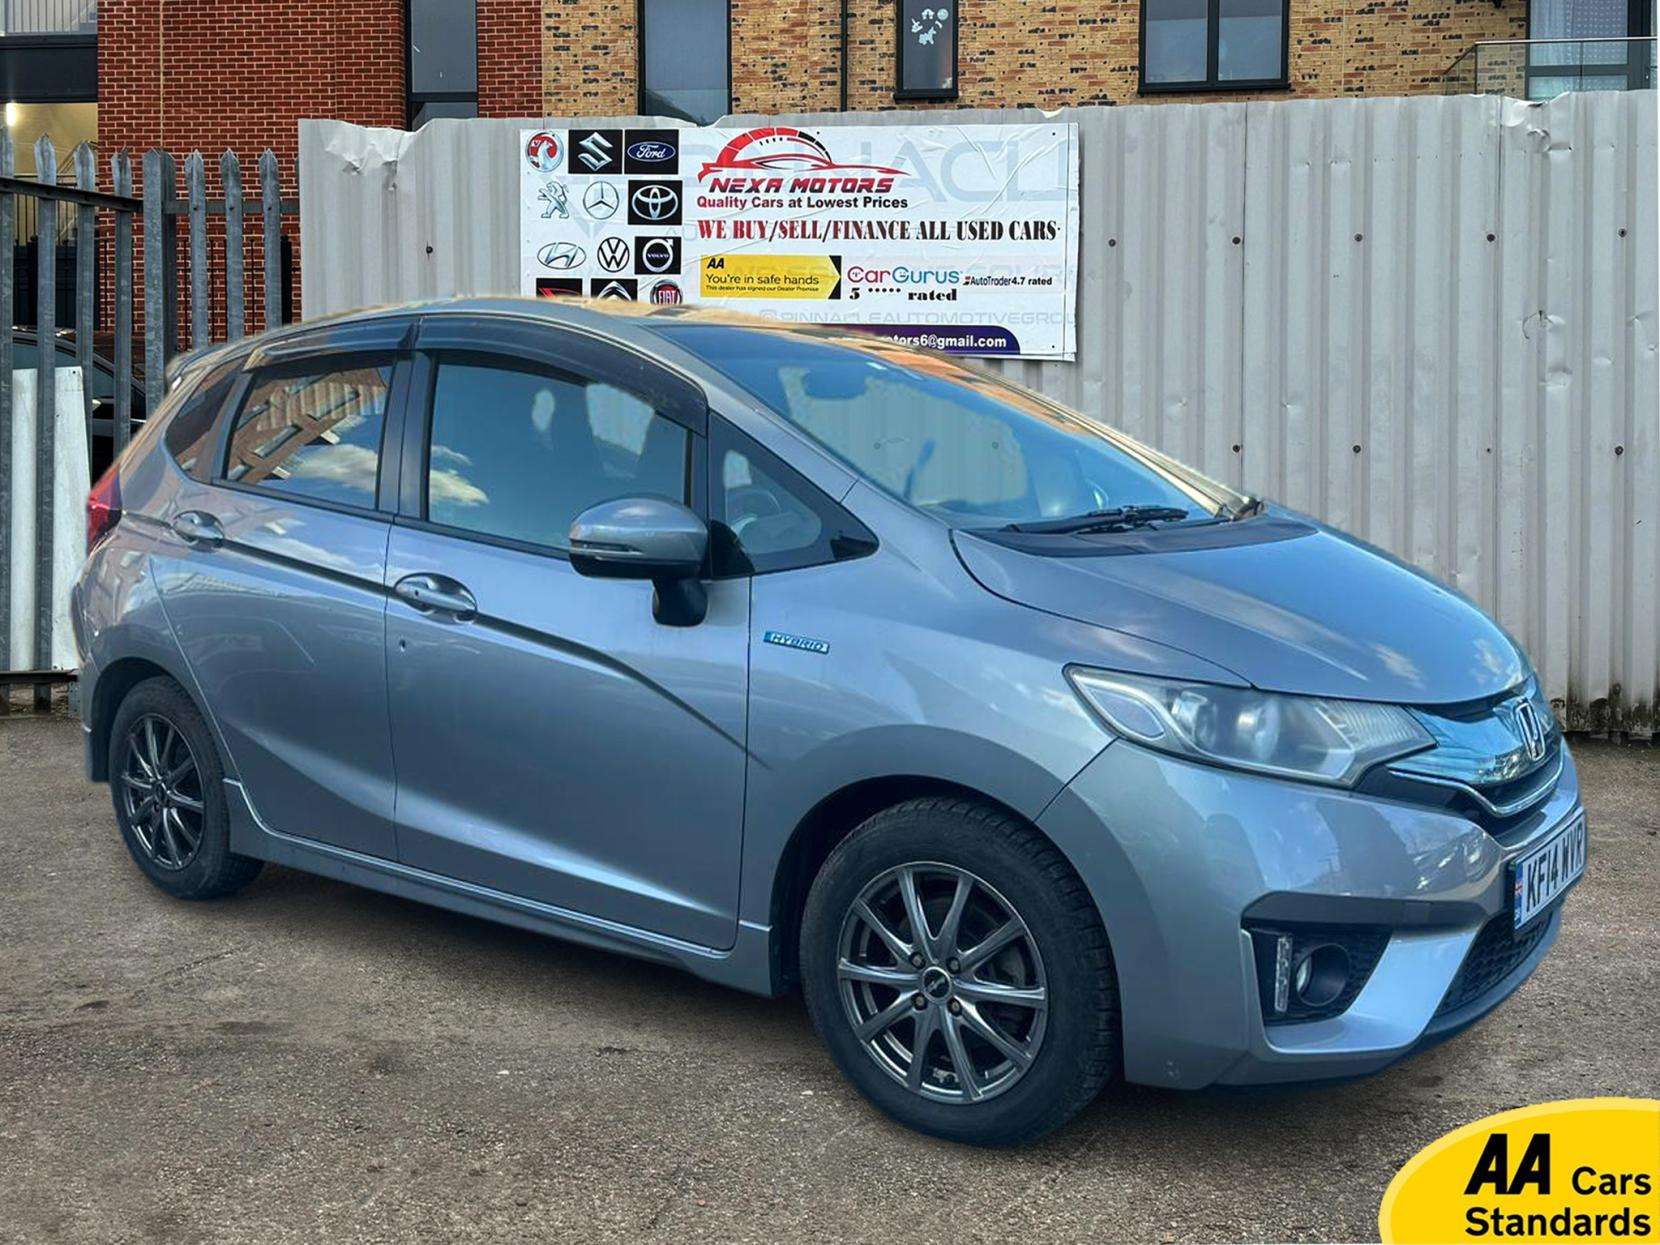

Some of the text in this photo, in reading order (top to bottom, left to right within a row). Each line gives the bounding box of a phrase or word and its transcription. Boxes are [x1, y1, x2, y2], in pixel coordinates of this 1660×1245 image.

[636, 144, 665, 158] Ford
[709, 178, 894, 193] NEXA MOTORS
[697, 196, 908, 210] Quality Cars at Lowest Prices
[697, 220, 726, 240] WE
[733, 220, 911, 243] BUY/SELL/FINANCE
[916, 221, 951, 240] ALL
[957, 221, 1003, 240] USED
[1009, 221, 1057, 240] CARS
[707, 258, 725, 269] AA
[706, 274, 819, 285] You're in safe hands
[848, 266, 961, 284] CarGurus
[1028, 277, 1053, 286] rated
[658, 290, 676, 305] FIAT
[849, 287, 957, 301] 5 rated
